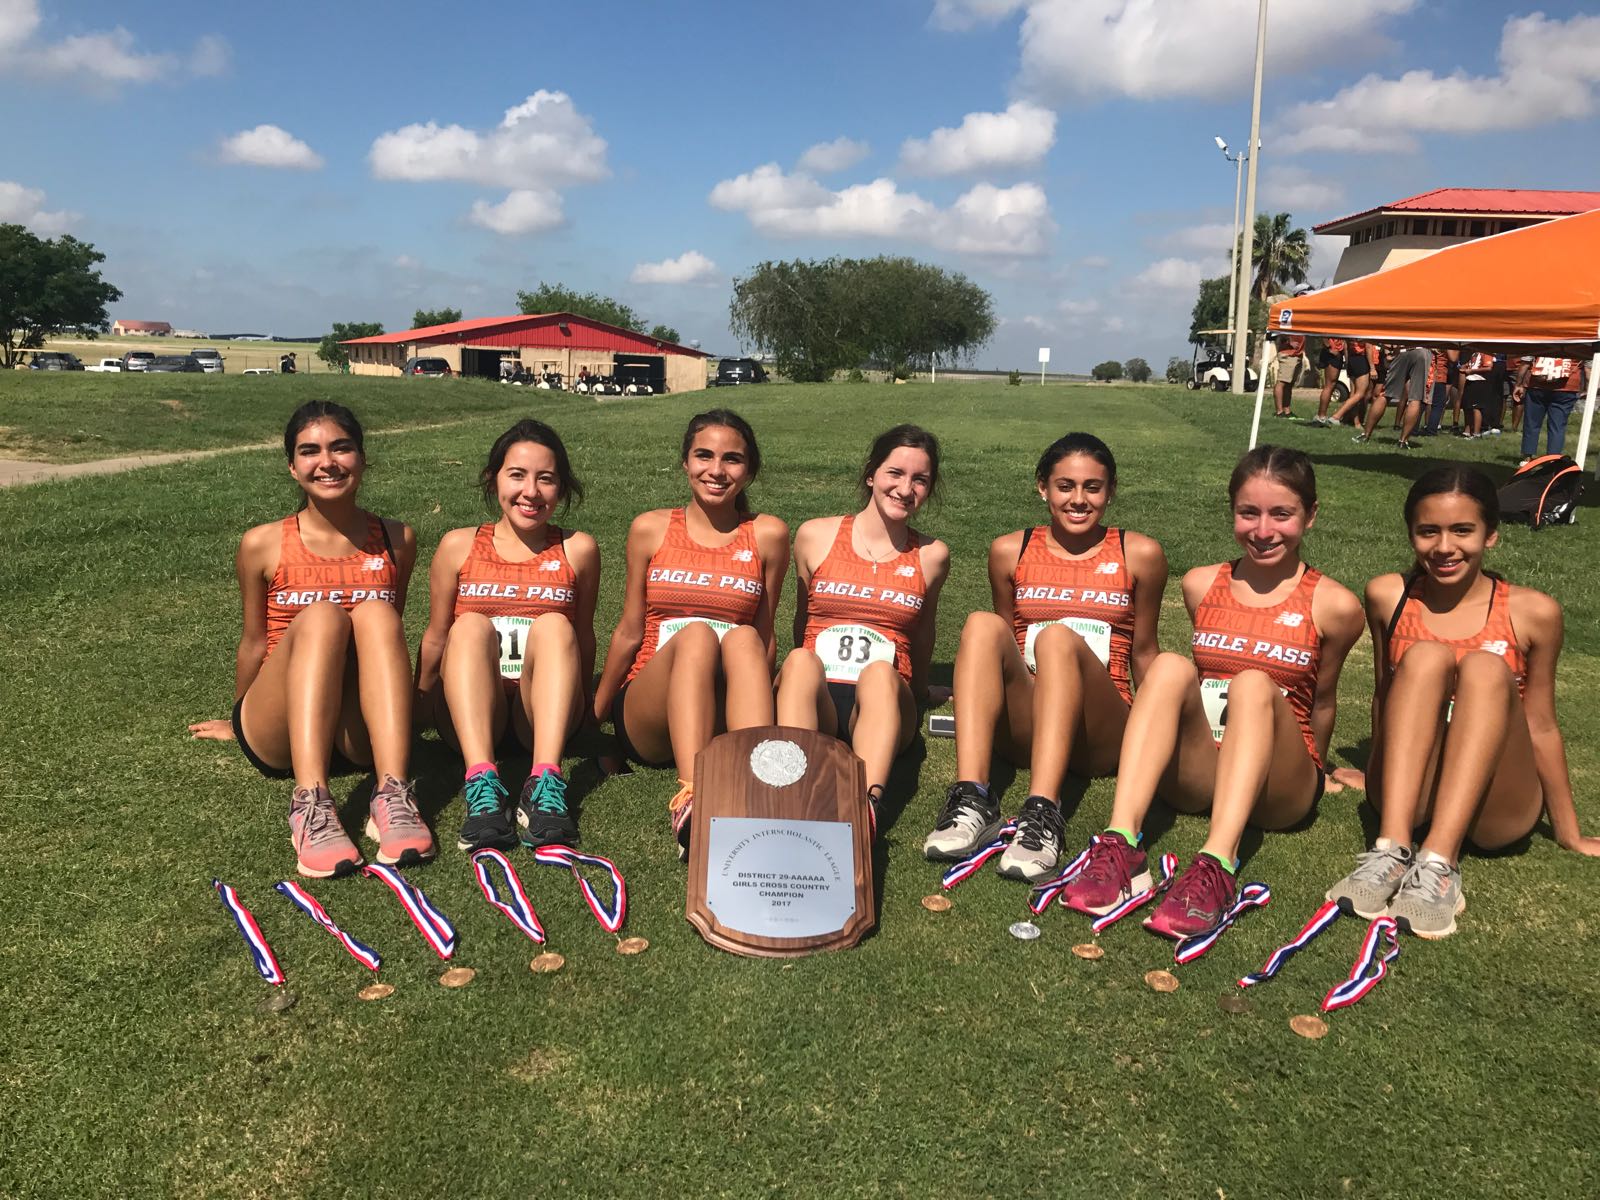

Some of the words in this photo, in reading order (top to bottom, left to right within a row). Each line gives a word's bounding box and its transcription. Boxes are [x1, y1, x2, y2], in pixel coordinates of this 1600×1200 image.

[650, 569, 713, 586] EAGLE
[720, 575, 763, 596] PASS
[276, 589, 344, 605] EAGLE
[350, 590, 396, 604] PASS
[458, 584, 520, 598] EAGLE
[526, 586, 576, 602] PASS
[814, 581, 875, 599] EAGLE
[880, 590, 924, 610] PASS
[1016, 587, 1075, 601] EAGLE
[1080, 590, 1130, 607] PASS
[1070, 622, 1105, 635] TIMING
[838, 635, 872, 664] 83
[1192, 631, 1248, 652] EAGLE
[1252, 640, 1312, 666] PASS
[824, 664, 847, 672] WIFT
[1204, 680, 1229, 688] SWIF
[722, 838, 750, 877] UNIVERSITY
[752, 828, 823, 851] INTERSCHOLASTIC
[824, 851, 840, 881] LEAGUE
[738, 872, 776, 880] DISTRICT
[732, 880, 758, 888] GIRLS
[790, 883, 830, 891] COUNTRY
[758, 890, 804, 898] CHAMPION
